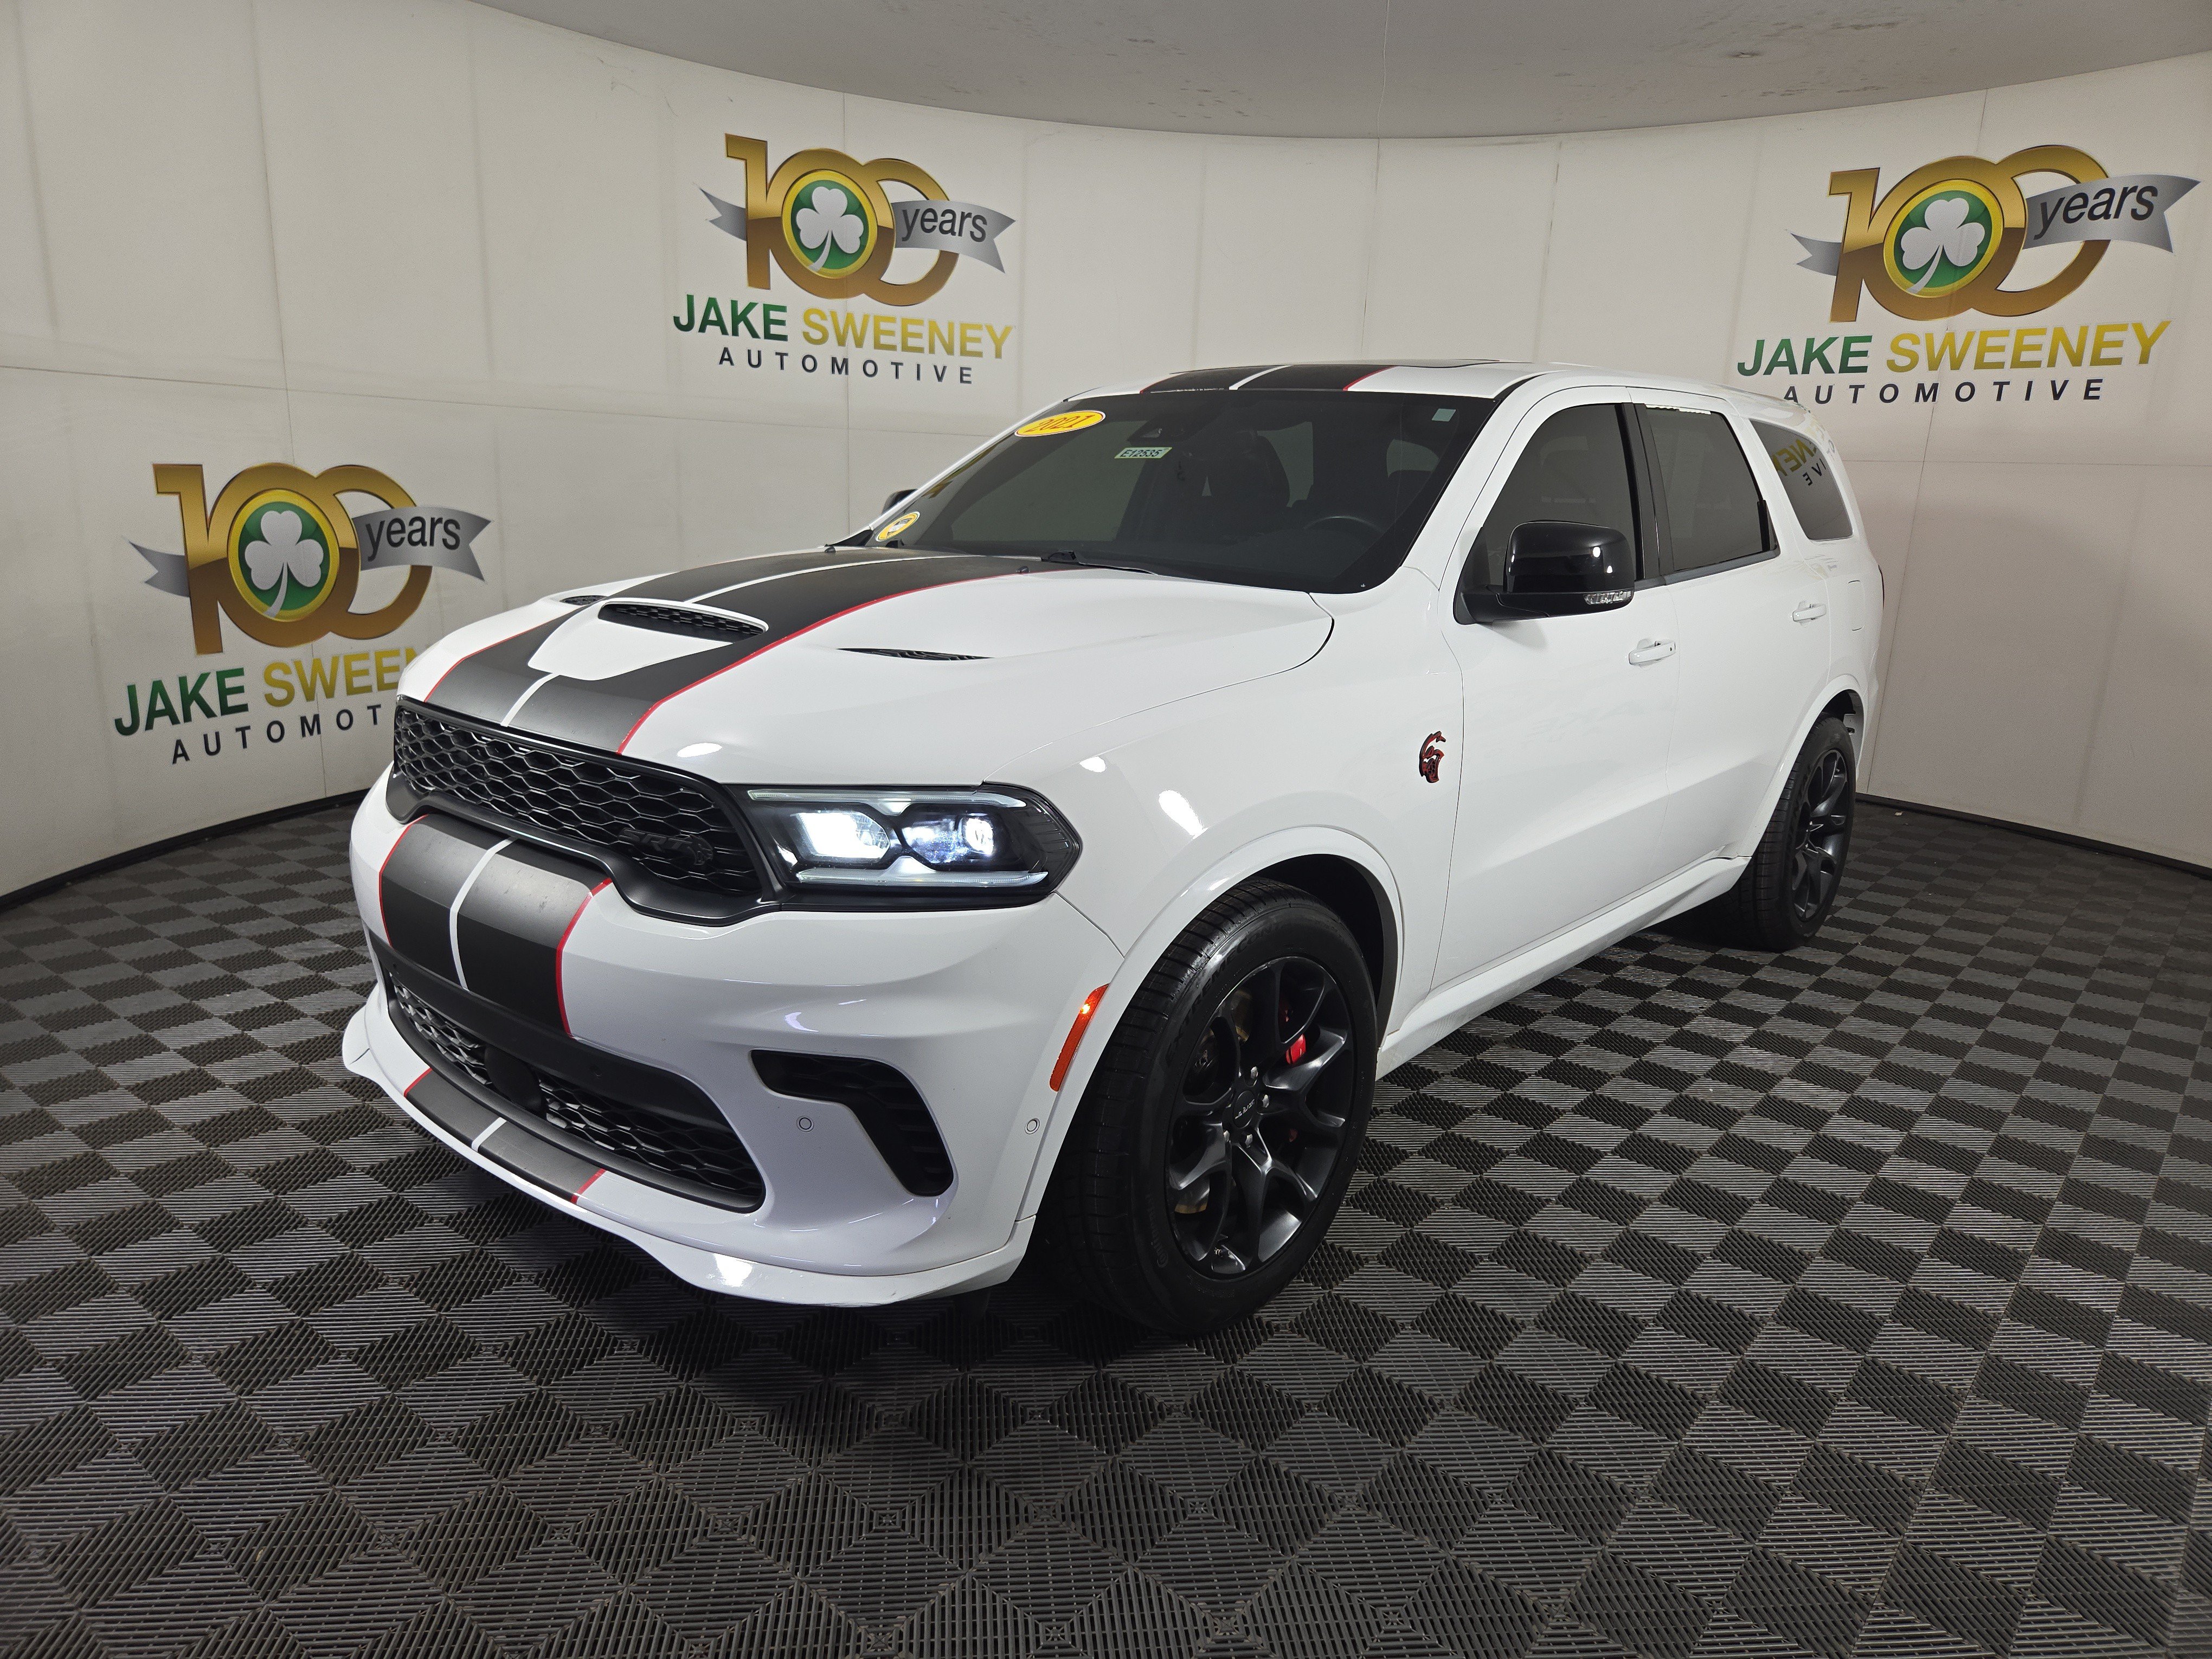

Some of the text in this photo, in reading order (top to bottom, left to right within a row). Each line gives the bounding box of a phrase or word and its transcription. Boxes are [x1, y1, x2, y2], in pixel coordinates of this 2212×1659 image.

[901, 207, 988, 243] years
[2034, 183, 2159, 240] years
[673, 294, 1013, 359] JAKE SWEENEY
[719, 347, 973, 384] AUTOMOTIVE
[1737, 320, 2171, 377] JAKE SWEENEY
[1783, 378, 2104, 404] AUTOMOTIVE
[1023, 414, 1096, 433] 2021
[1120, 449, 1163, 458] E12535
[365, 516, 461, 562] years
[114, 667, 249, 736] JAKE
[172, 704, 382, 764] AUTOMOT
[618, 827, 693, 853] SRT
